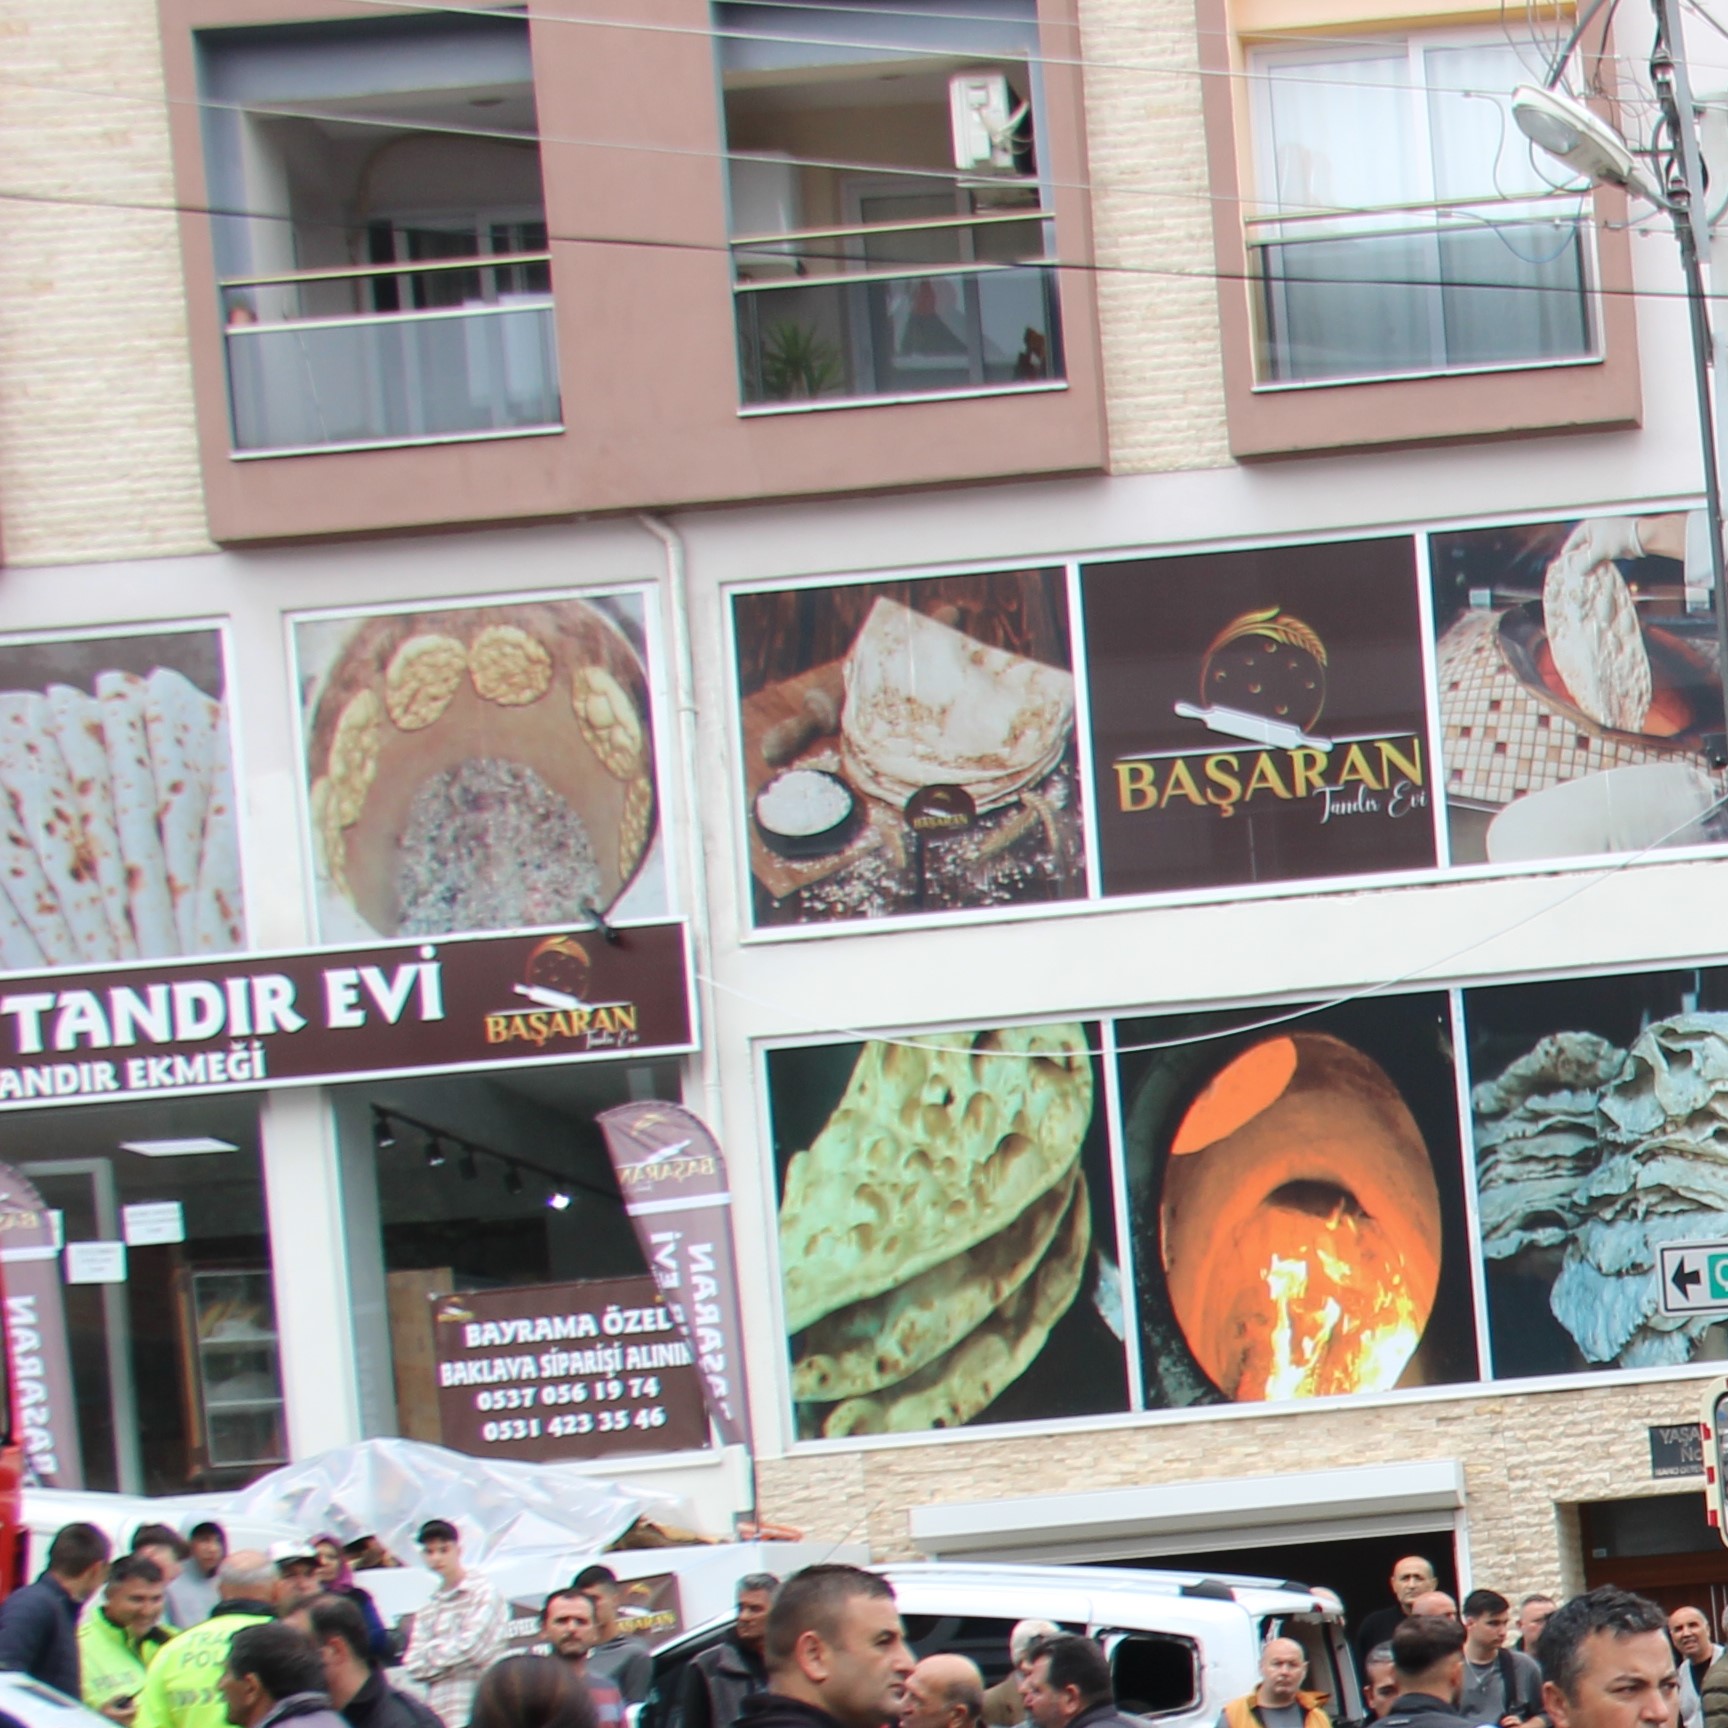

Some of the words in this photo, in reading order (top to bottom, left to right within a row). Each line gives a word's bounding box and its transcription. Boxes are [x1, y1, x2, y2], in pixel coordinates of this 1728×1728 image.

[1112, 738, 1424, 819] BAŞARAN
[1388, 780, 1428, 819] Evi
[0, 973, 308, 1055] TANDIR
[324, 944, 446, 1030] EVİ
[484, 1002, 639, 1047] BAŞARAN
[126, 1040, 268, 1090] EKMEĞİ
[464, 1312, 600, 1349] BAYRAMA
[602, 1304, 675, 1337] ÖZEL
[439, 1354, 539, 1388] BAKLAVA
[540, 1339, 625, 1380] SİPARİŞİ
[476, 1385, 539, 1412] 0537
[541, 1381, 589, 1407] 056
[594, 1377, 625, 1401] 19
[628, 1375, 662, 1400] 74
[481, 1417, 543, 1443] 0531
[547, 1411, 595, 1438] 423
[598, 1408, 631, 1433] 35
[634, 1405, 668, 1431] 46
